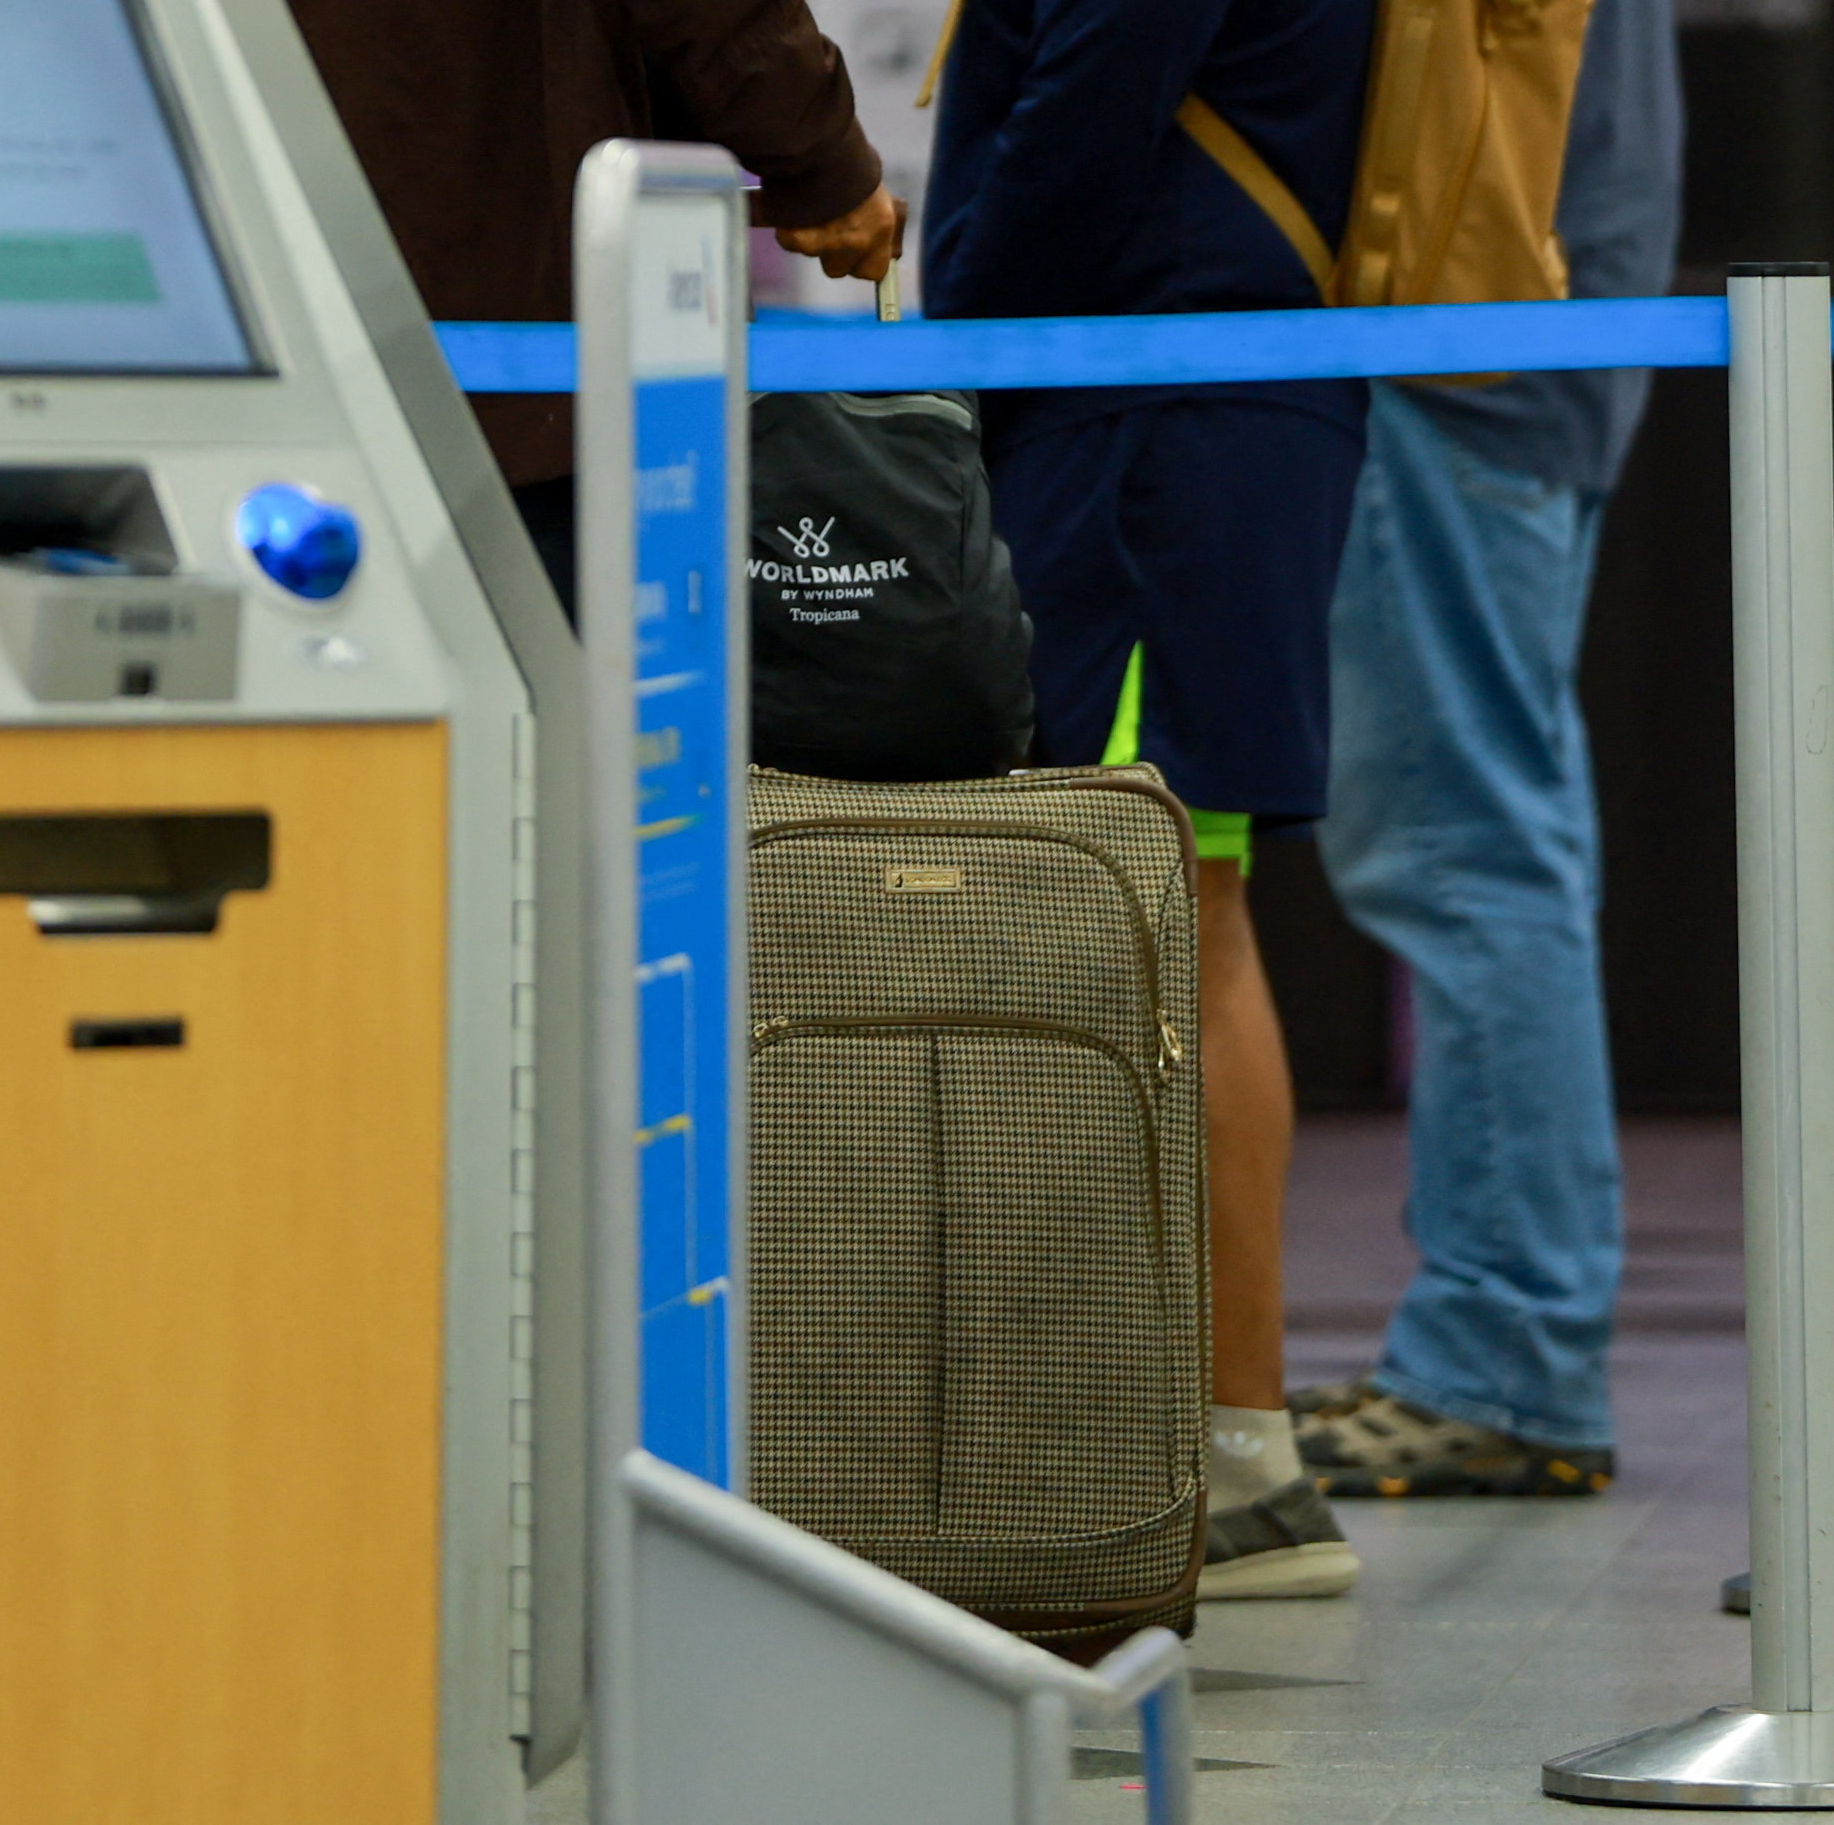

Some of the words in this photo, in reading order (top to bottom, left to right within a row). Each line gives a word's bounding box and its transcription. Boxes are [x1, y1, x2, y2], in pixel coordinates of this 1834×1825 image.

[745, 557, 910, 584] WORLDMARK
[781, 590, 798, 600] BY
[803, 587, 874, 600] WYNDHAM
[789, 607, 860, 625] Tropicana
